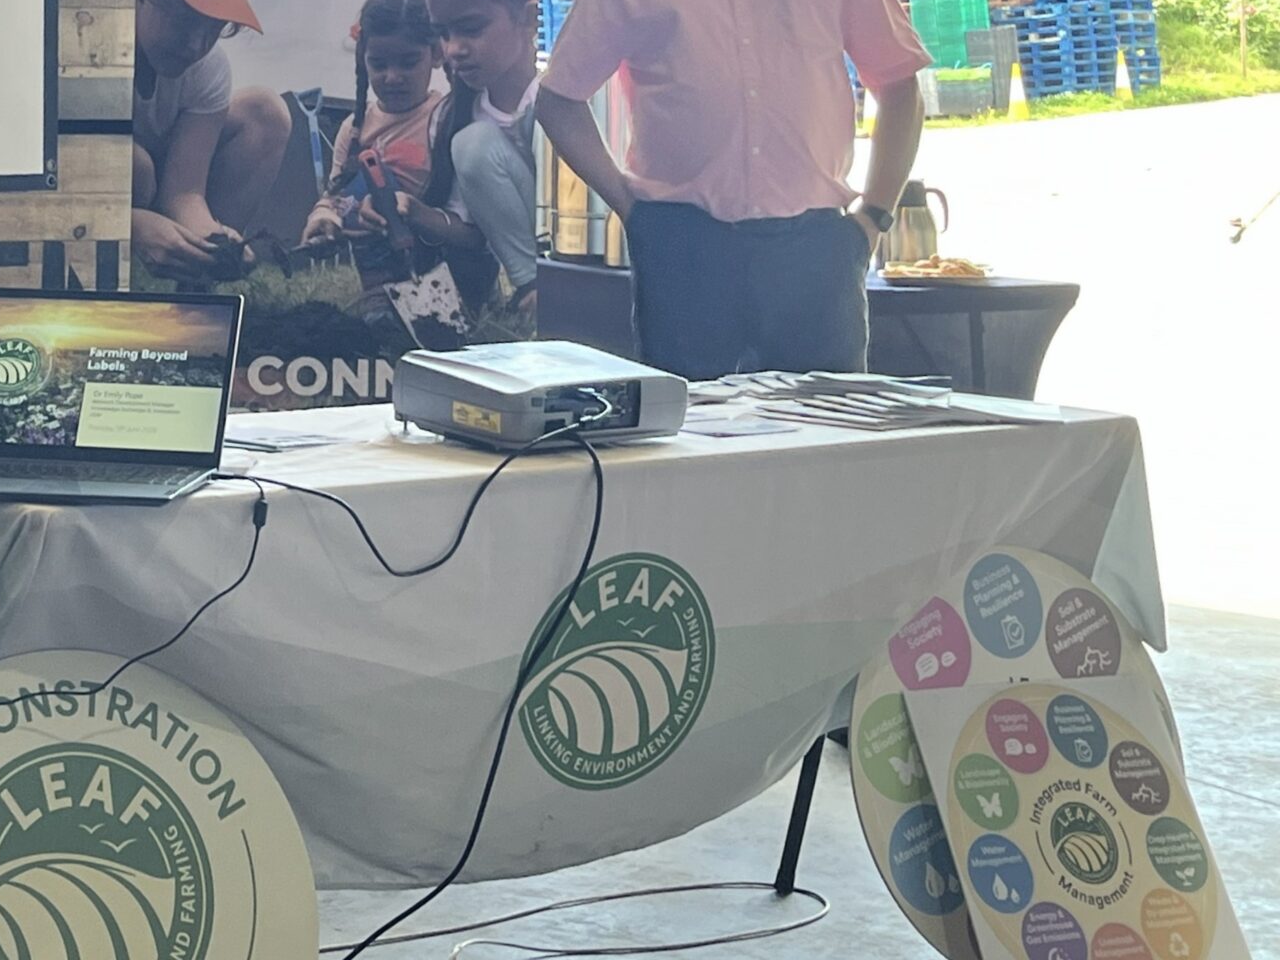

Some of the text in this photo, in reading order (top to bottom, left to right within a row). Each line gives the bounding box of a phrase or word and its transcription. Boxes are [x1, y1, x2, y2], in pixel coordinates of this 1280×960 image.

[87, 359, 126, 372] Labels
[89, 346, 189, 363] Farming Beyond
[569, 567, 685, 630] LEAF
[972, 578, 1014, 607] Planning
[979, 589, 1025, 619] Resilience
[1055, 607, 1097, 637] Substrate
[1058, 601, 1074, 619] Soil
[907, 624, 944, 650] Society
[1053, 614, 1110, 655] Management
[533, 606, 703, 776] LINKING ENVIRONMENT AND FARMING
[0, 761, 163, 832] LEAF
[1030, 778, 1118, 825] Integrated Farm
[1057, 807, 1097, 828] LEAF
[163, 824, 196, 924] FARMING
[1058, 870, 1134, 910] Management
[169, 931, 191, 960] ND
